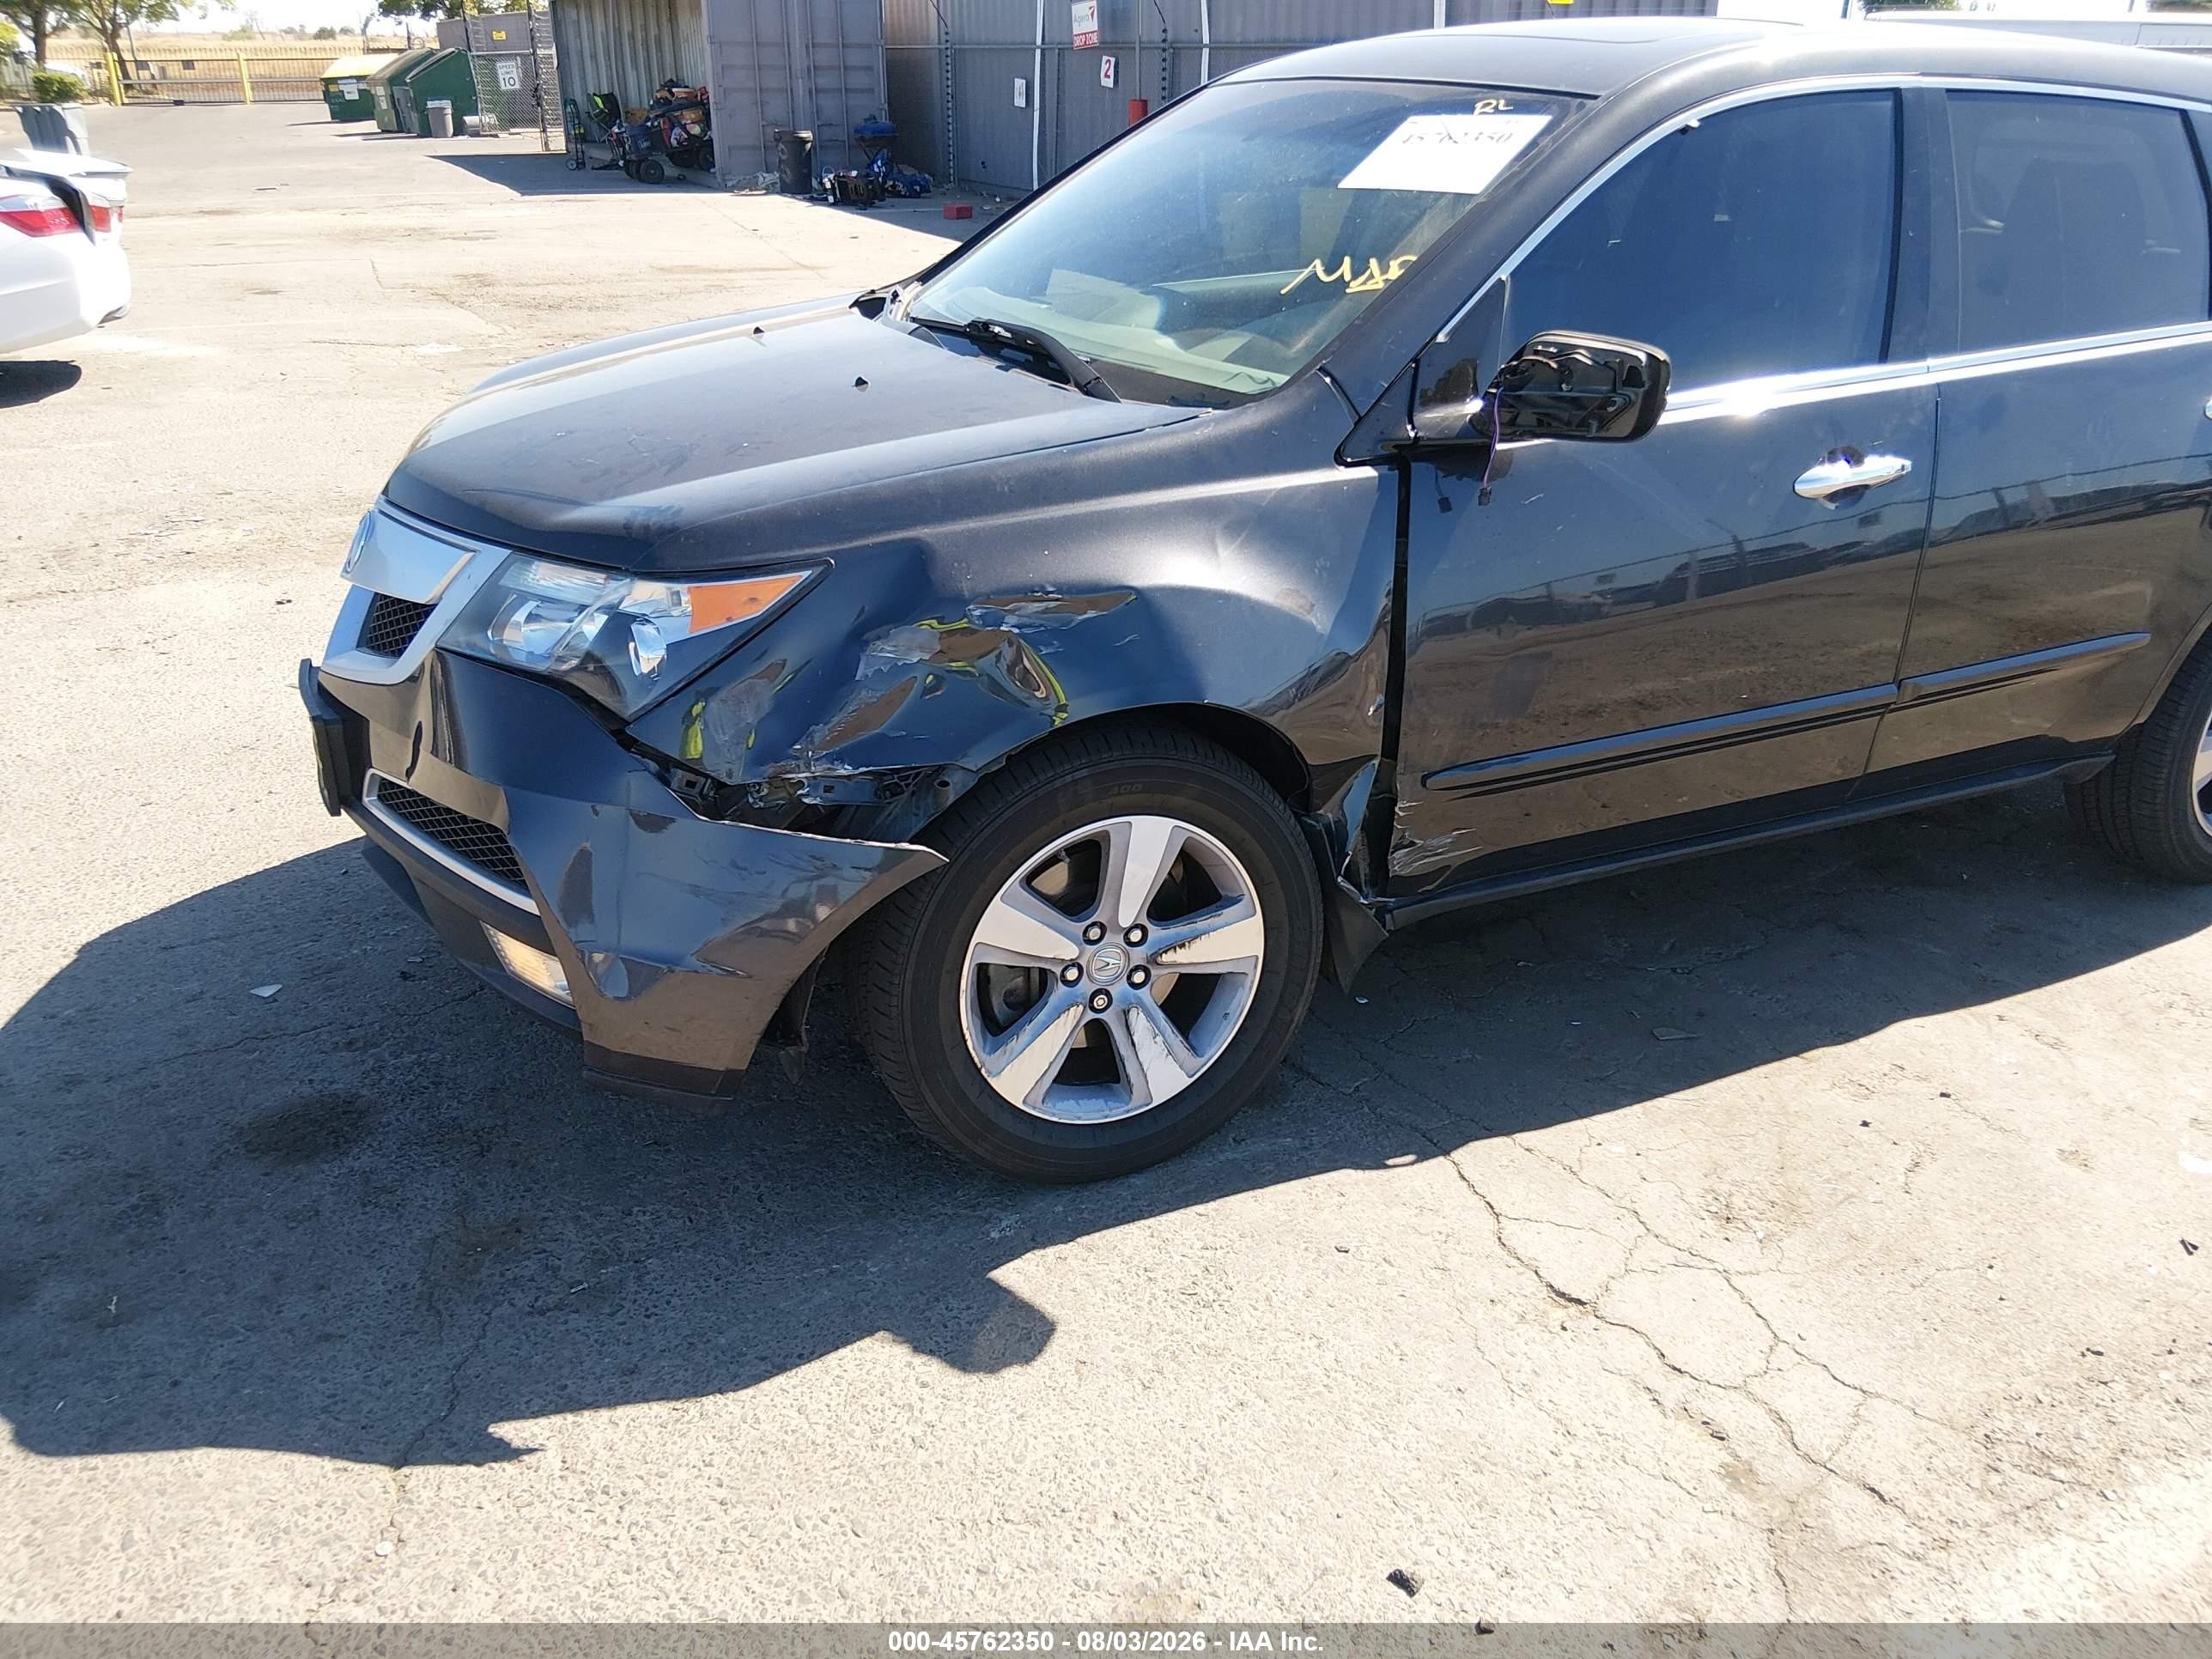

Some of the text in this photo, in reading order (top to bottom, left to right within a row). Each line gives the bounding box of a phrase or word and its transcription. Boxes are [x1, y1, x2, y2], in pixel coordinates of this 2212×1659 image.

[1073, 32, 1098, 47] DROP ZONE
[1103, 58, 1112, 79] 2
[502, 76, 516, 87] 10
